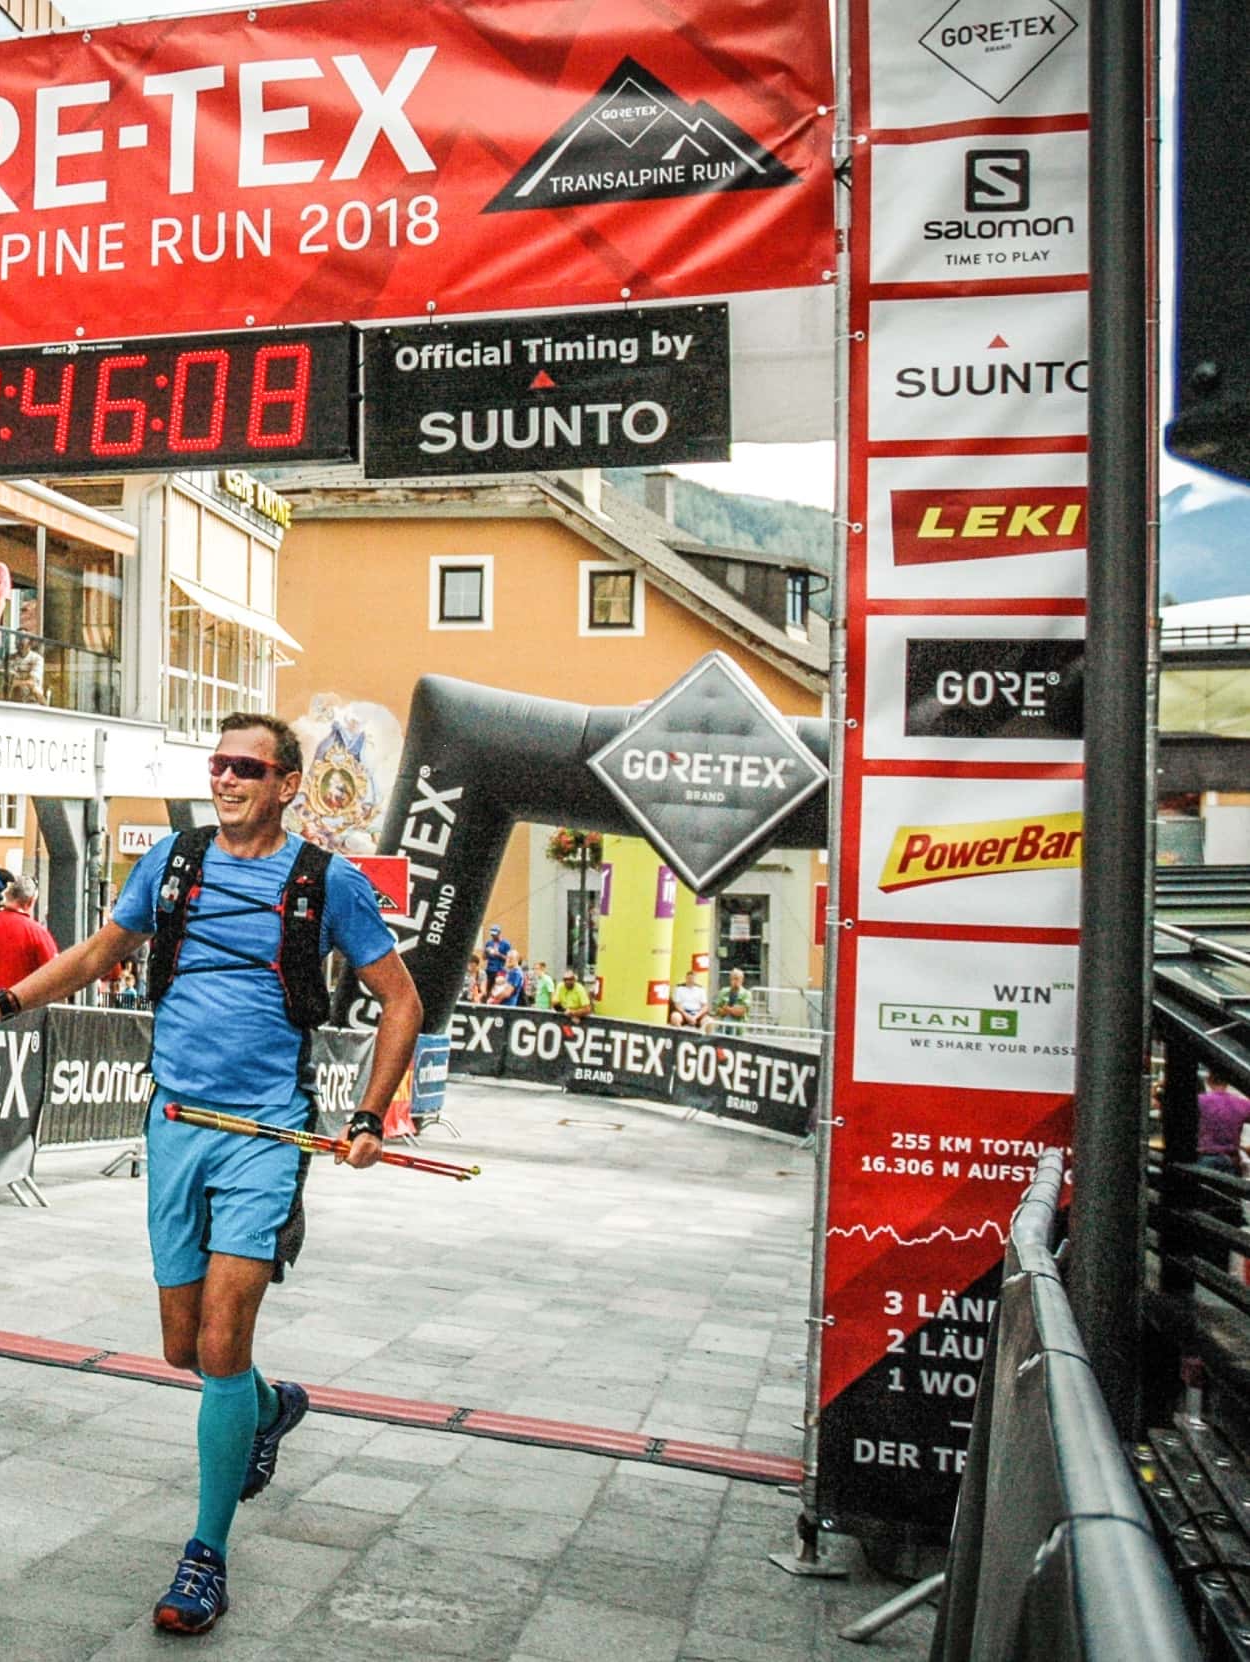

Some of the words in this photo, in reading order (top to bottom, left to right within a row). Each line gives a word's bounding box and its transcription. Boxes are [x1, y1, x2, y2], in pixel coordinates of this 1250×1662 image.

[941, 15, 1056, 47] GORE-TEX
[602, 105, 658, 120] GORE-TEX
[549, 165, 685, 193] TRANSALPINE
[693, 161, 736, 182] RUN
[151, 207, 272, 267] RUN
[299, 194, 440, 256] 2018
[945, 253, 981, 265] TIME
[987, 252, 1007, 264] TO
[1012, 249, 1050, 262] PLAY
[395, 340, 512, 371] Official
[522, 334, 639, 364] Timing
[651, 329, 693, 361] by
[418, 400, 669, 454] SUUNTO
[917, 504, 1082, 538] LEKI
[685, 789, 725, 802] BRAND
[426, 883, 456, 945] BRAND
[993, 984, 1052, 1005] WIN
[891, 1011, 969, 1028] PLAN
[990, 1017, 1010, 1030] B
[910, 1038, 930, 1048] WE
[937, 1039, 983, 1051] SHARE
[989, 1043, 1027, 1055] YOUR
[575, 1067, 614, 1084] BRAND
[726, 1094, 759, 1115] BRAND
[891, 1132, 931, 1151] 255
[939, 1136, 971, 1153] KM
[861, 1155, 934, 1176] 16.306
[942, 1161, 959, 1178] M
[883, 1290, 903, 1316] 3
[886, 1328, 906, 1354] 2
[919, 1327, 985, 1361] LÄU
[888, 1367, 905, 1392] 1
[920, 1369, 977, 1397] WO
[853, 1438, 921, 1469] DER
